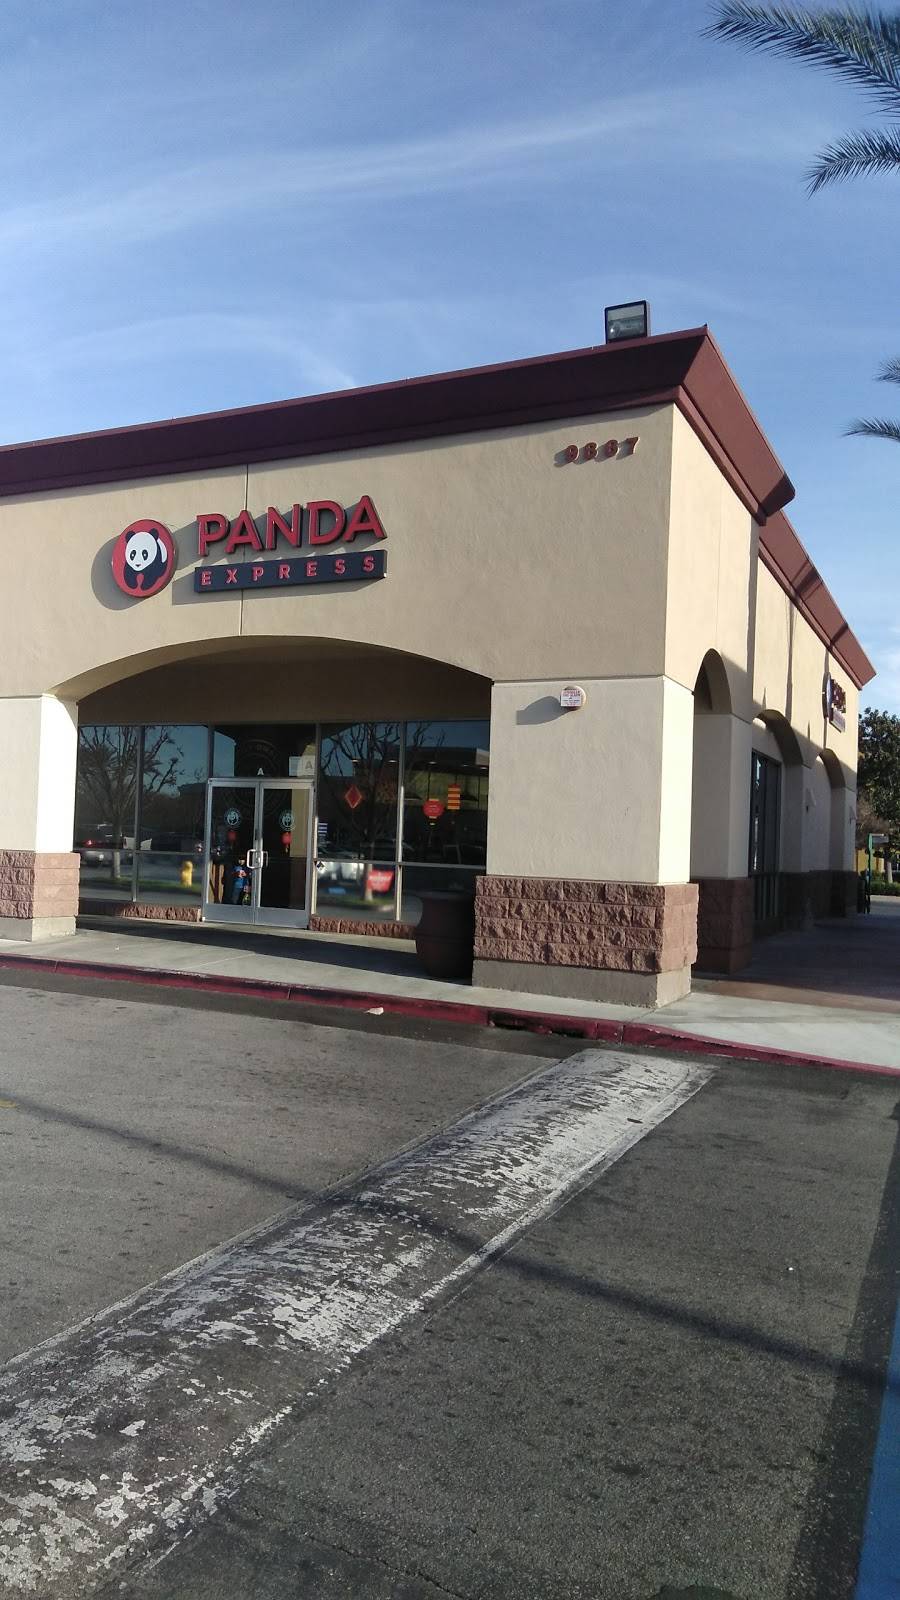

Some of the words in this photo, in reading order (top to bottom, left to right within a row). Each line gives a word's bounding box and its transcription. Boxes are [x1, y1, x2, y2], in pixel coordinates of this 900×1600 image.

[196, 495, 387, 556] PANDA
[200, 555, 376, 586] EXPRESS
[257, 767, 264, 776] A
